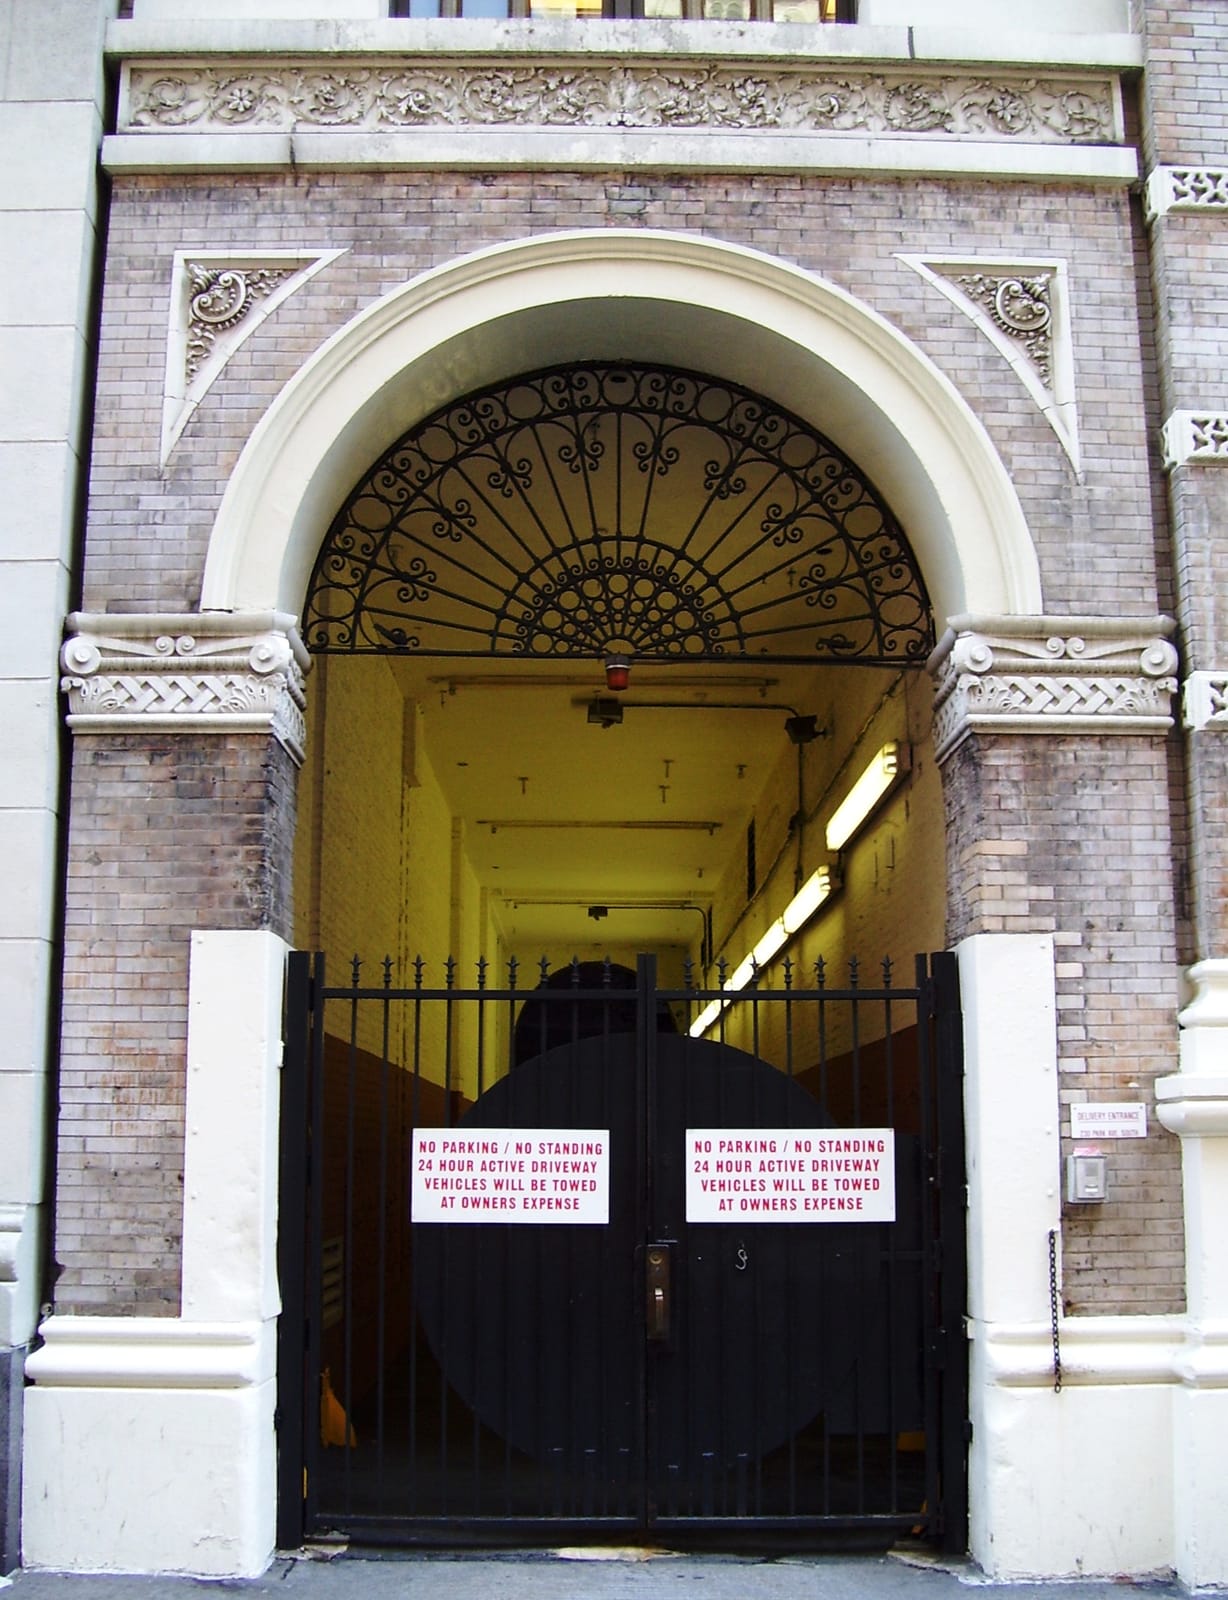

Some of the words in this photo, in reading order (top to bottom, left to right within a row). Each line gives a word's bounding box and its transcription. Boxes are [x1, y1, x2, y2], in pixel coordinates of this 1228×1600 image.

[1077, 1111, 1105, 1120] DELIVERY
[1108, 1111, 1139, 1120] ENTRANCE
[418, 1141, 436, 1153] NO
[442, 1141, 498, 1154] PARKING
[515, 1142, 532, 1154] NO
[539, 1142, 603, 1155] STANDING
[694, 1141, 712, 1153] NO
[718, 1140, 777, 1153] PARKING
[794, 1140, 812, 1153] NO
[819, 1140, 885, 1153] STANDING
[417, 1159, 433, 1171] 24
[438, 1160, 474, 1172] HOUR
[479, 1160, 524, 1172] ACTIVE
[531, 1160, 597, 1174] DRIVEWAY
[694, 1160, 710, 1173] 24
[715, 1160, 752, 1173] HOUR
[758, 1159, 804, 1173] ACTIVE
[811, 1159, 880, 1172] DRIVEWAY
[424, 1178, 487, 1191] VEHICLES
[493, 1179, 524, 1191] WILL
[530, 1179, 547, 1191] BE
[553, 1179, 597, 1192] TOWED
[701, 1179, 766, 1192] VEHICLES
[773, 1179, 804, 1192] WILL
[811, 1178, 828, 1192] BE
[834, 1178, 880, 1192] TOWED
[440, 1196, 456, 1208] AT
[461, 1196, 516, 1209] OWNERS
[522, 1197, 580, 1210] EXPENSE
[718, 1198, 734, 1211] AT
[739, 1198, 797, 1211] OWNERS
[803, 1197, 863, 1211] EXPENSE
